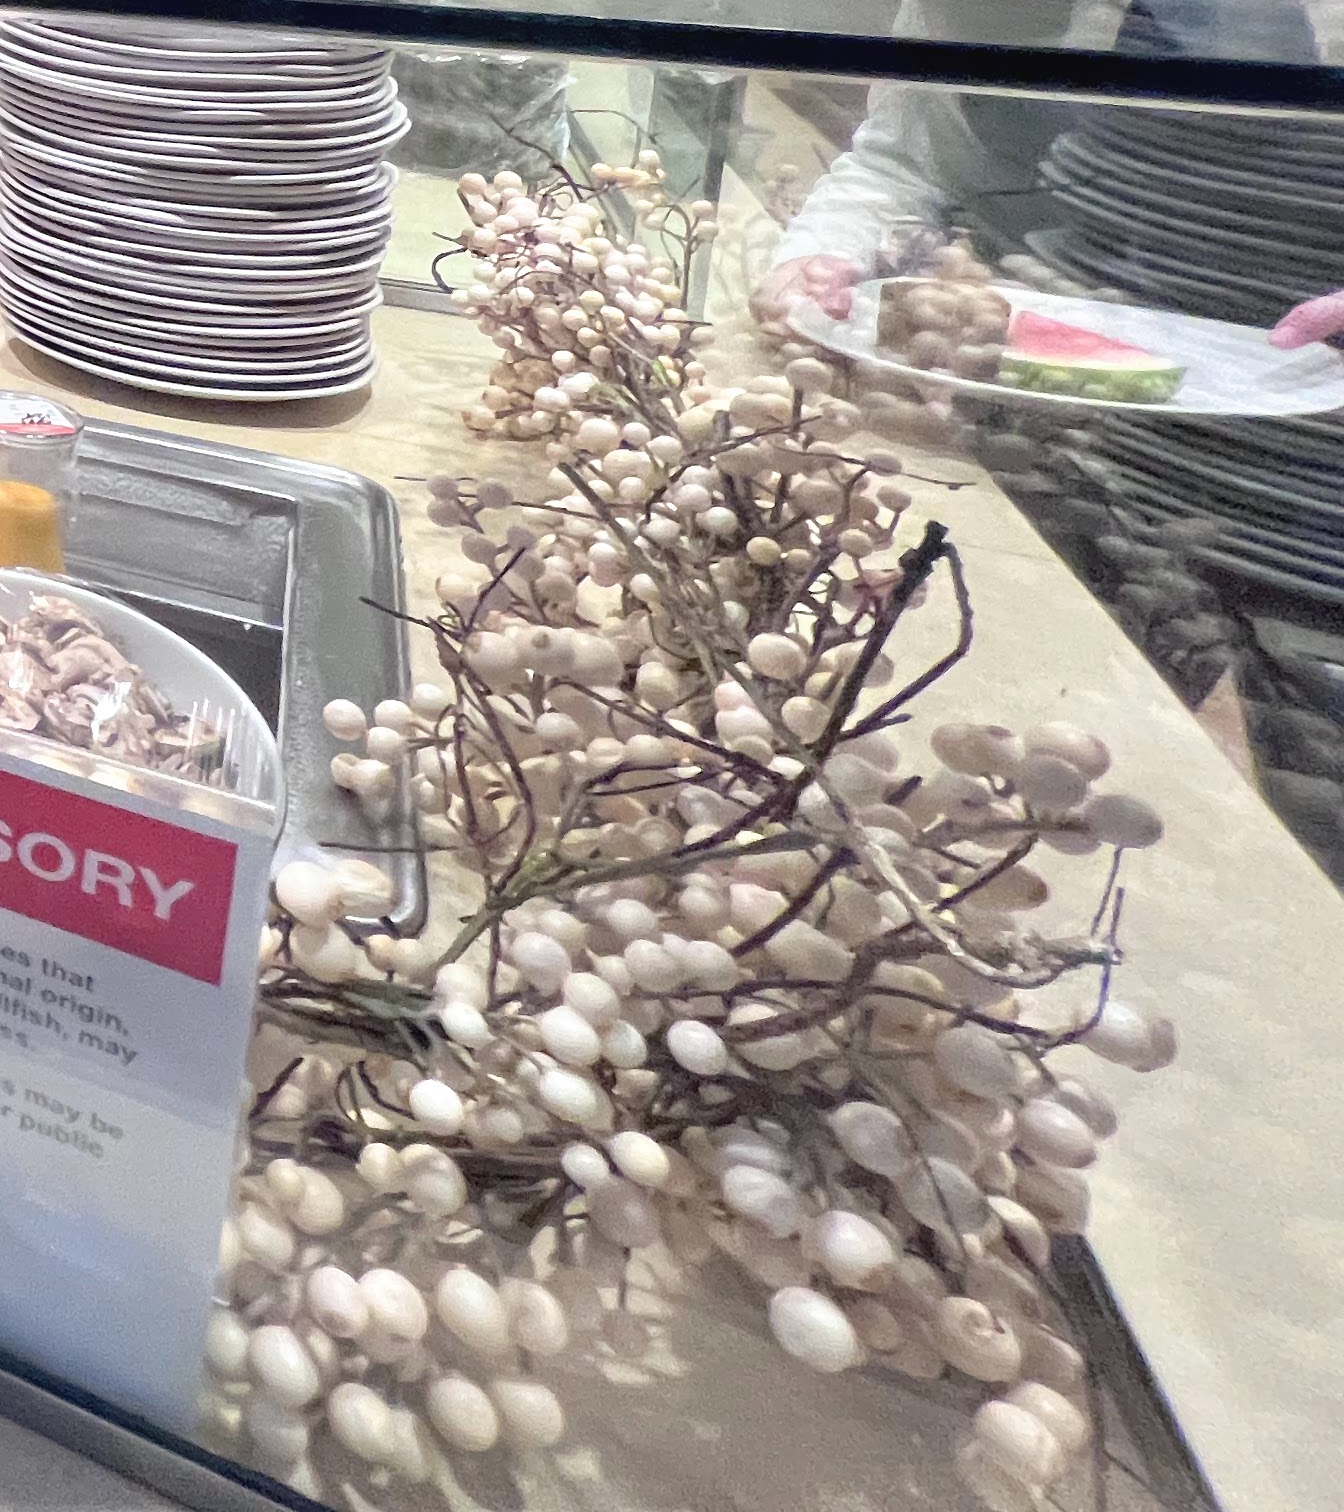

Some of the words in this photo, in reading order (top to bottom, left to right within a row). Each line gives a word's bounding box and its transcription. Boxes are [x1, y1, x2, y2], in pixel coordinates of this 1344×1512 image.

[40, 957, 95, 993] that
[77, 1029, 139, 1067] may
[23, 1087, 81, 1123] may
[89, 1111, 124, 1140] be
